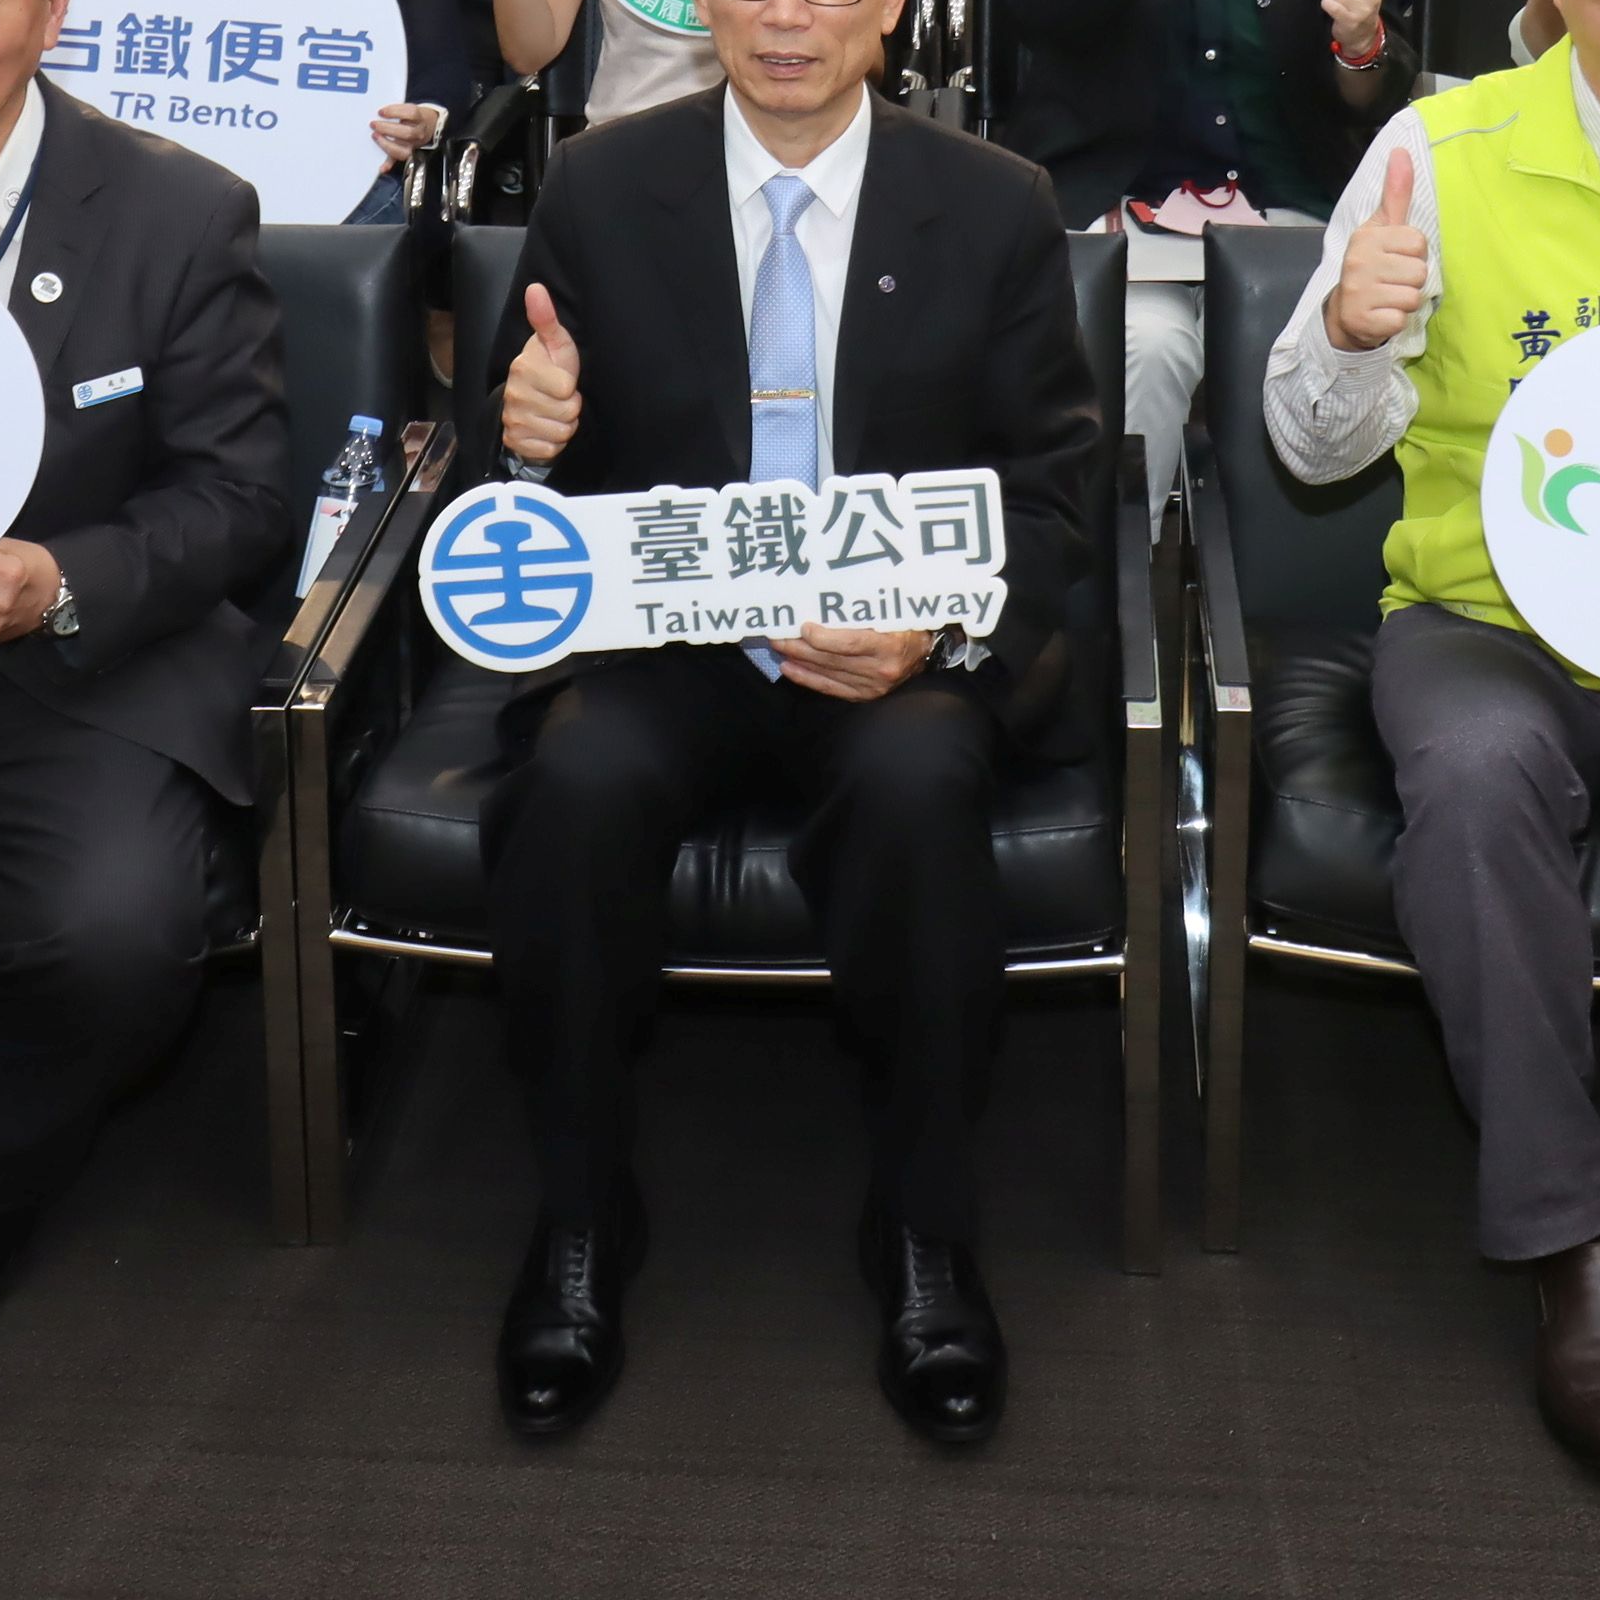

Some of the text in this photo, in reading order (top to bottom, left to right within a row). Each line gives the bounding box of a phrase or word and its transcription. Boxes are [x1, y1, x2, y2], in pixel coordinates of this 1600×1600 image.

[110, 90, 279, 131] TR Bento
[625, 482, 993, 584] 臺鐵公司
[636, 584, 994, 636] Taiwan Railway
